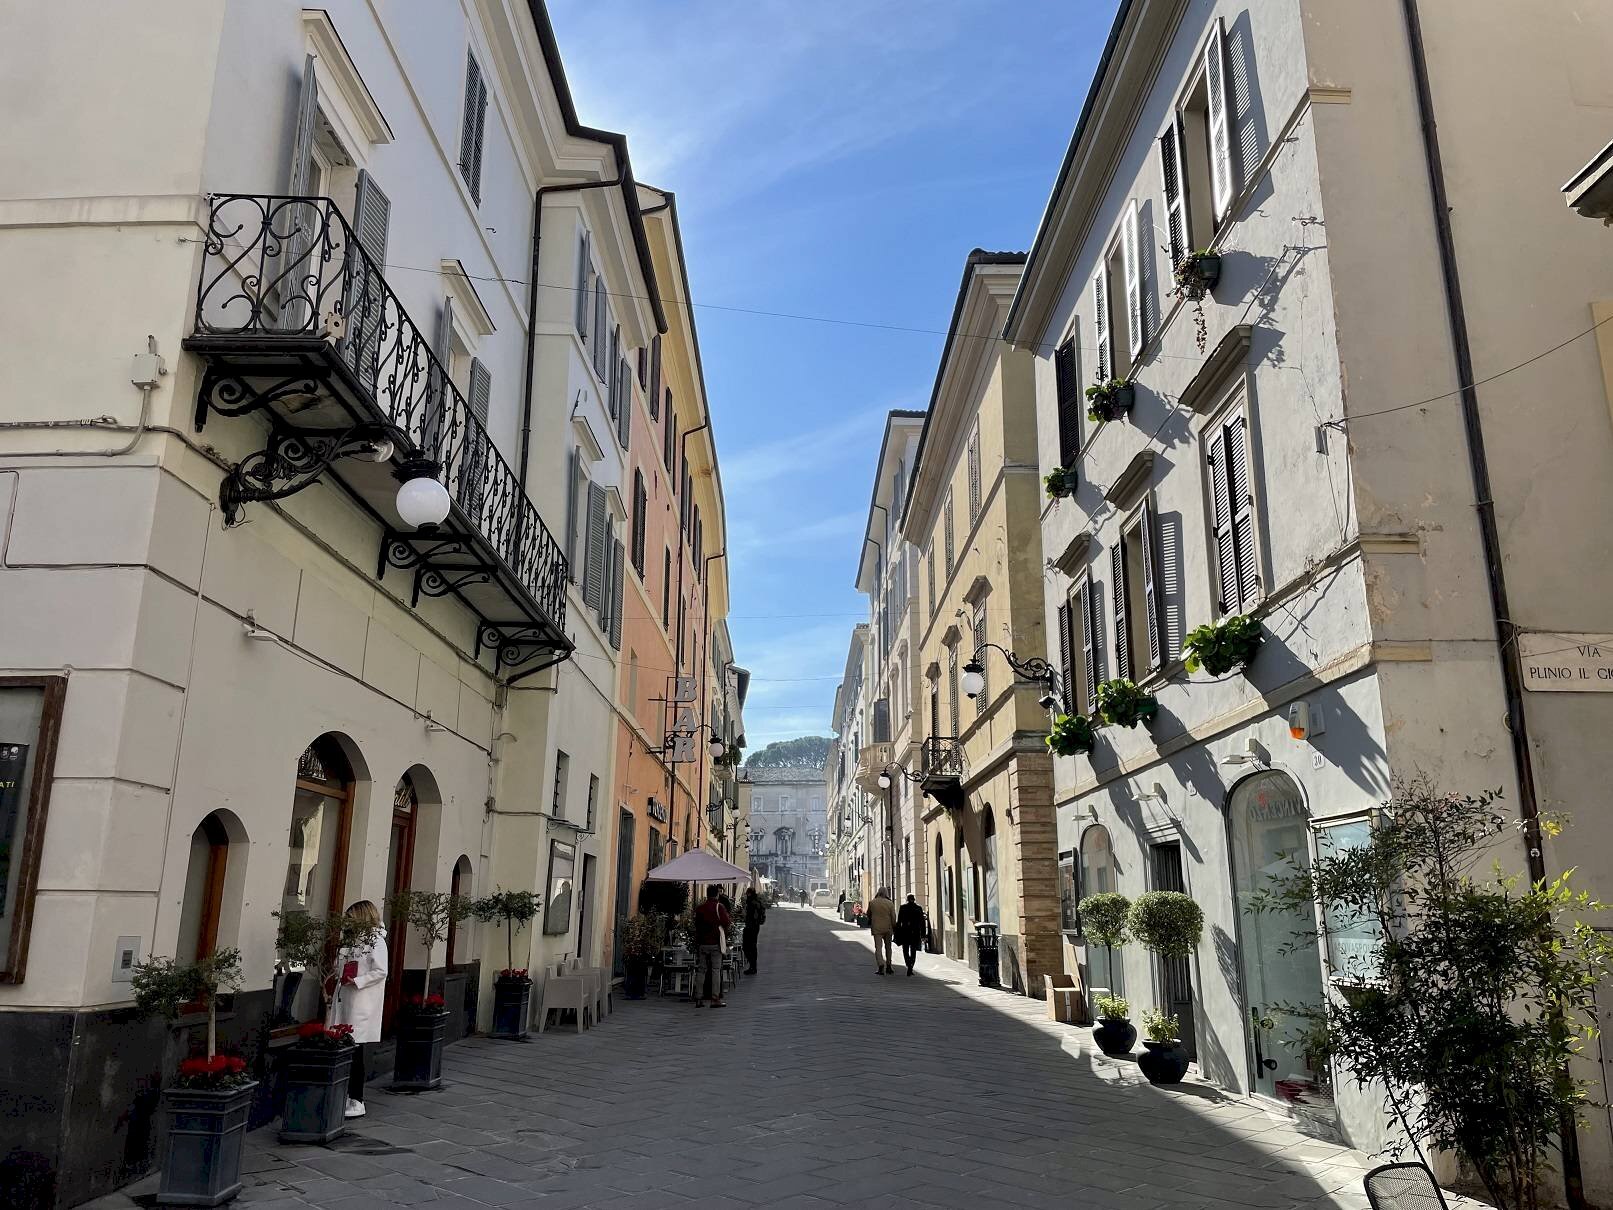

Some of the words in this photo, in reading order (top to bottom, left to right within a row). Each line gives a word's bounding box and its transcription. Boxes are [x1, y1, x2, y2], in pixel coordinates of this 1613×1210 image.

[1577, 645, 1602, 657] VIA
[1529, 667, 1572, 679] PLINIO
[1579, 667, 1590, 679] IL
[1597, 668, 1613, 679] GI
[672, 676, 697, 762] BAR
